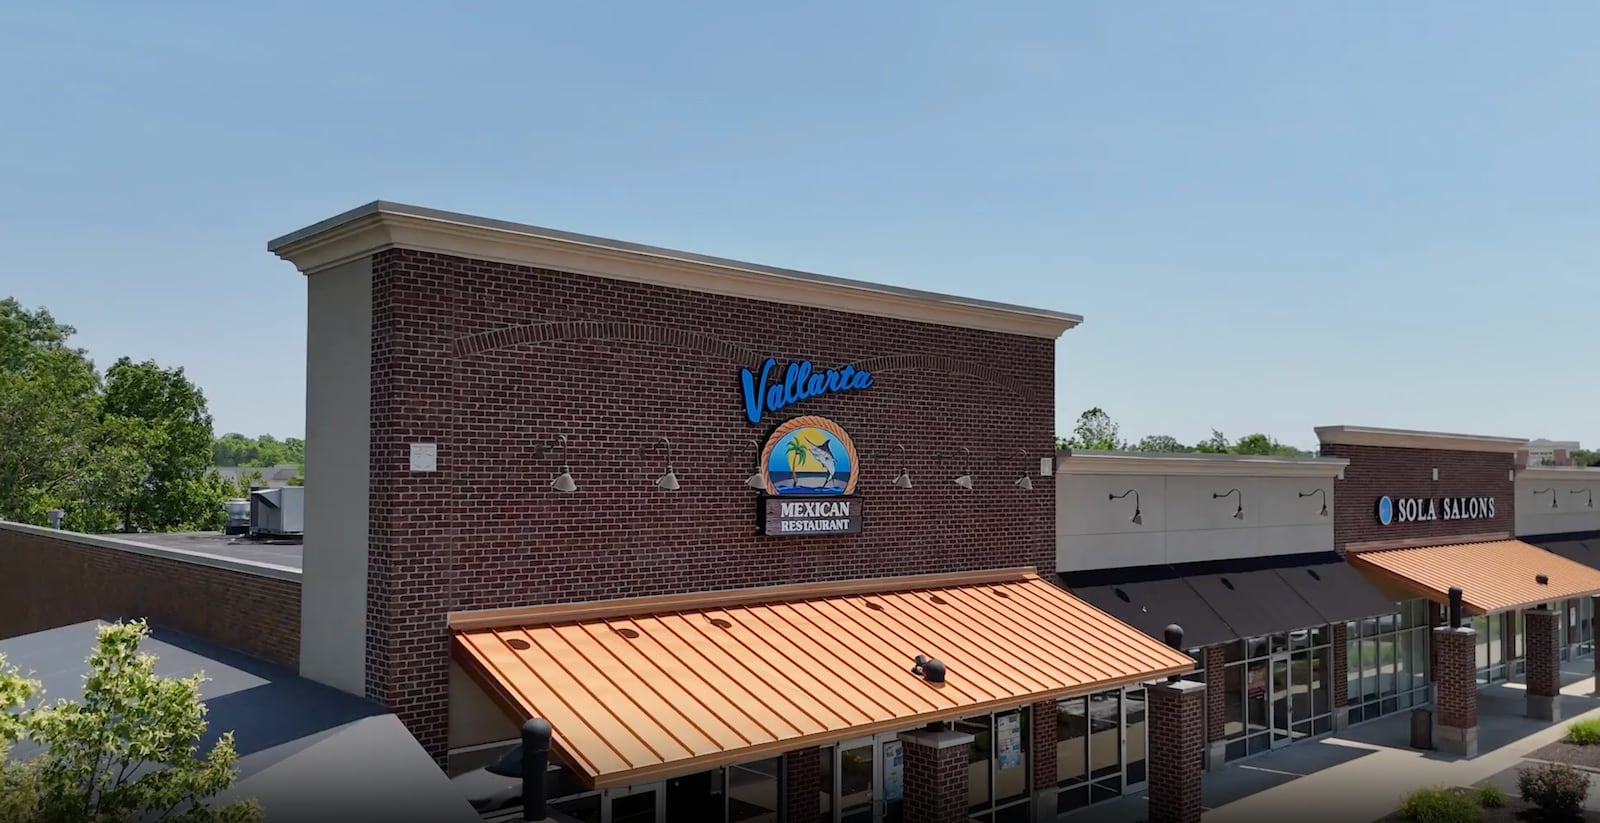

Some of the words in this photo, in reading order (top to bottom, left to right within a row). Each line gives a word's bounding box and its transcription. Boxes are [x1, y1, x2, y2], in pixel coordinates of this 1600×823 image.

[741, 358, 875, 424] Vallarta
[780, 501, 850, 518] MEXICAN
[1398, 498, 1437, 522] SOLA
[1443, 496, 1495, 520] SALONS
[781, 518, 850, 532] RESTAURANT
